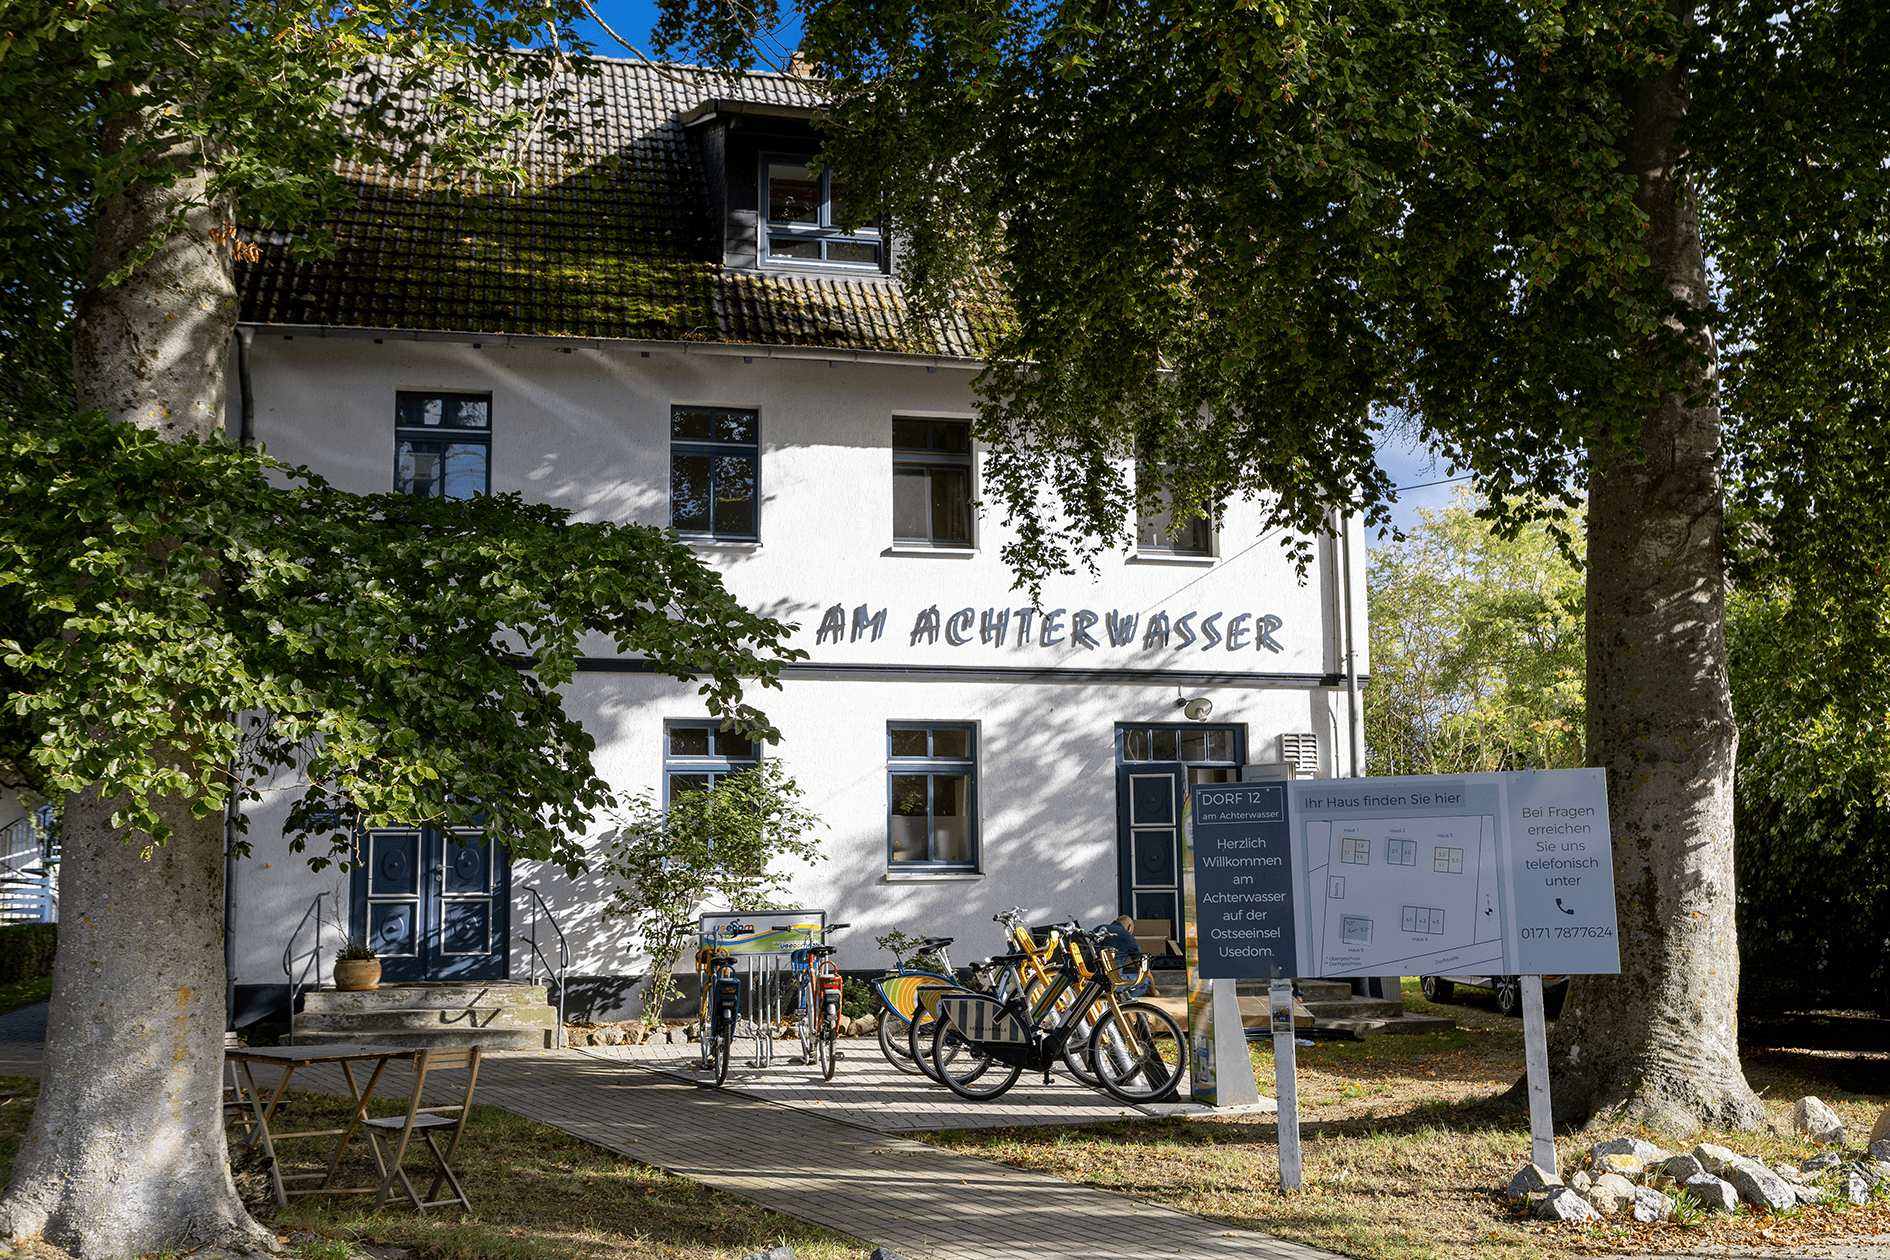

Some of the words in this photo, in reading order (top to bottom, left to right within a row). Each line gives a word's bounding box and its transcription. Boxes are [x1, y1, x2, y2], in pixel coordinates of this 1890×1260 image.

[816, 603, 887, 645] AM
[910, 603, 1285, 653] ACHTERWASSER
[1202, 793, 1243, 806] DORF
[1247, 792, 1261, 804] 12
[1305, 797, 1323, 808] Ihr
[1327, 797, 1360, 808] Haus
[1364, 795, 1407, 806] finden
[1410, 793, 1431, 805] Sie
[1435, 792, 1461, 804] hier
[1202, 812, 1217, 821] am
[1219, 810, 1279, 820] Achterwasser
[1522, 806, 1543, 818] Bei
[1548, 806, 1595, 819] Fragen
[1527, 823, 1591, 835] erreichen
[1217, 837, 1267, 849] Herzlich
[1536, 841, 1557, 852] Sie
[1561, 842, 1586, 852] uns
[1202, 856, 1282, 867] Willkommen
[1525, 857, 1599, 870] telefonisch
[1232, 875, 1253, 885] am
[1545, 876, 1581, 886] unter
[1202, 892, 1286, 903] Achterwasser
[1223, 909, 1244, 921] auf
[1246, 909, 1267, 920] der
[1211, 926, 1281, 939] Ostseeinsel
[1521, 927, 1550, 939] 0171
[1554, 926, 1613, 939] 7877624
[1219, 946, 1275, 957] Usedom.
